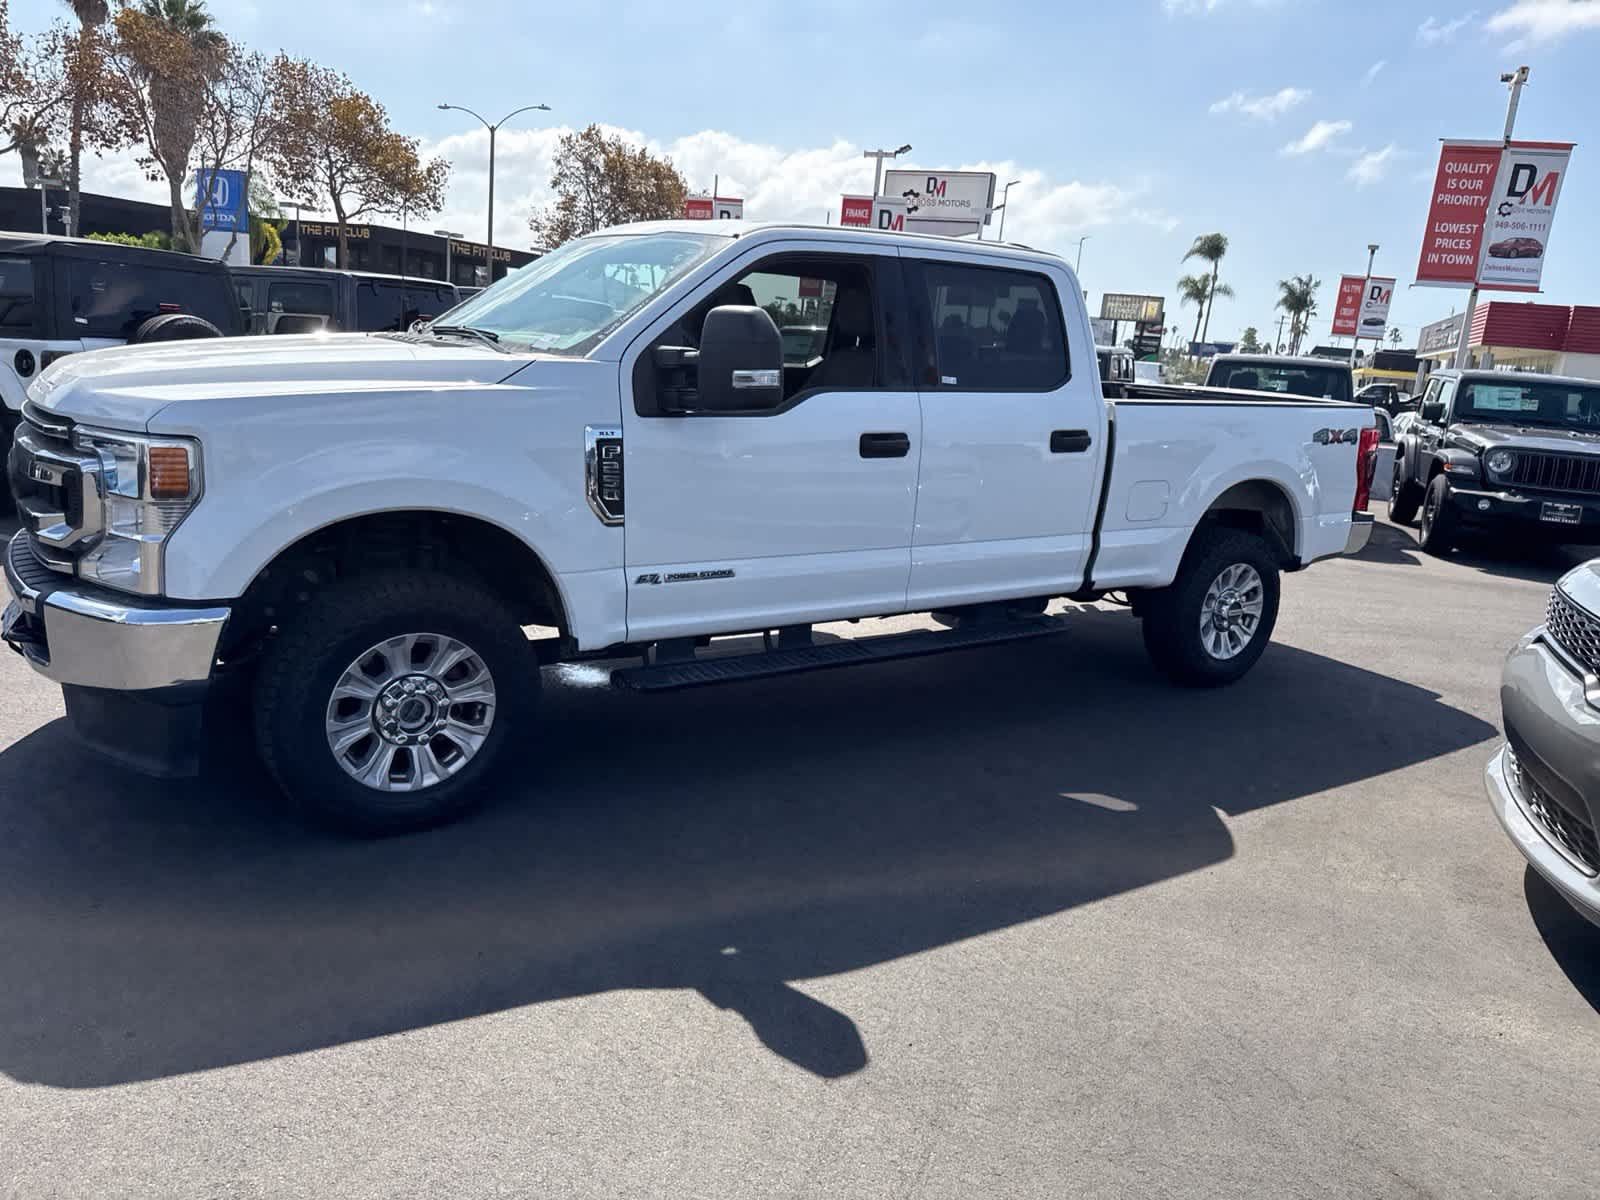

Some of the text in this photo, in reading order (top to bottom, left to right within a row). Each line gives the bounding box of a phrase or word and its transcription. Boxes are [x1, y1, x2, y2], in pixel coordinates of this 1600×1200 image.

[1445, 161, 1493, 174] QUALITY
[926, 176, 947, 198] DM
[1447, 178, 1483, 190] IS OUR
[1507, 163, 1560, 207] DM
[938, 199, 971, 209] MOTORS
[1437, 193, 1487, 207] PRIORITY
[845, 209, 869, 219] FINANCE
[301, 224, 369, 239] THE FIT CLUB
[1434, 222, 1479, 235] LOWEST
[450, 241, 470, 255] THE
[1435, 239, 1471, 250] PRICES
[1427, 253, 1474, 265] IN TOWN
[666, 572, 698, 581] POWER
[700, 569, 735, 578] STROKE
